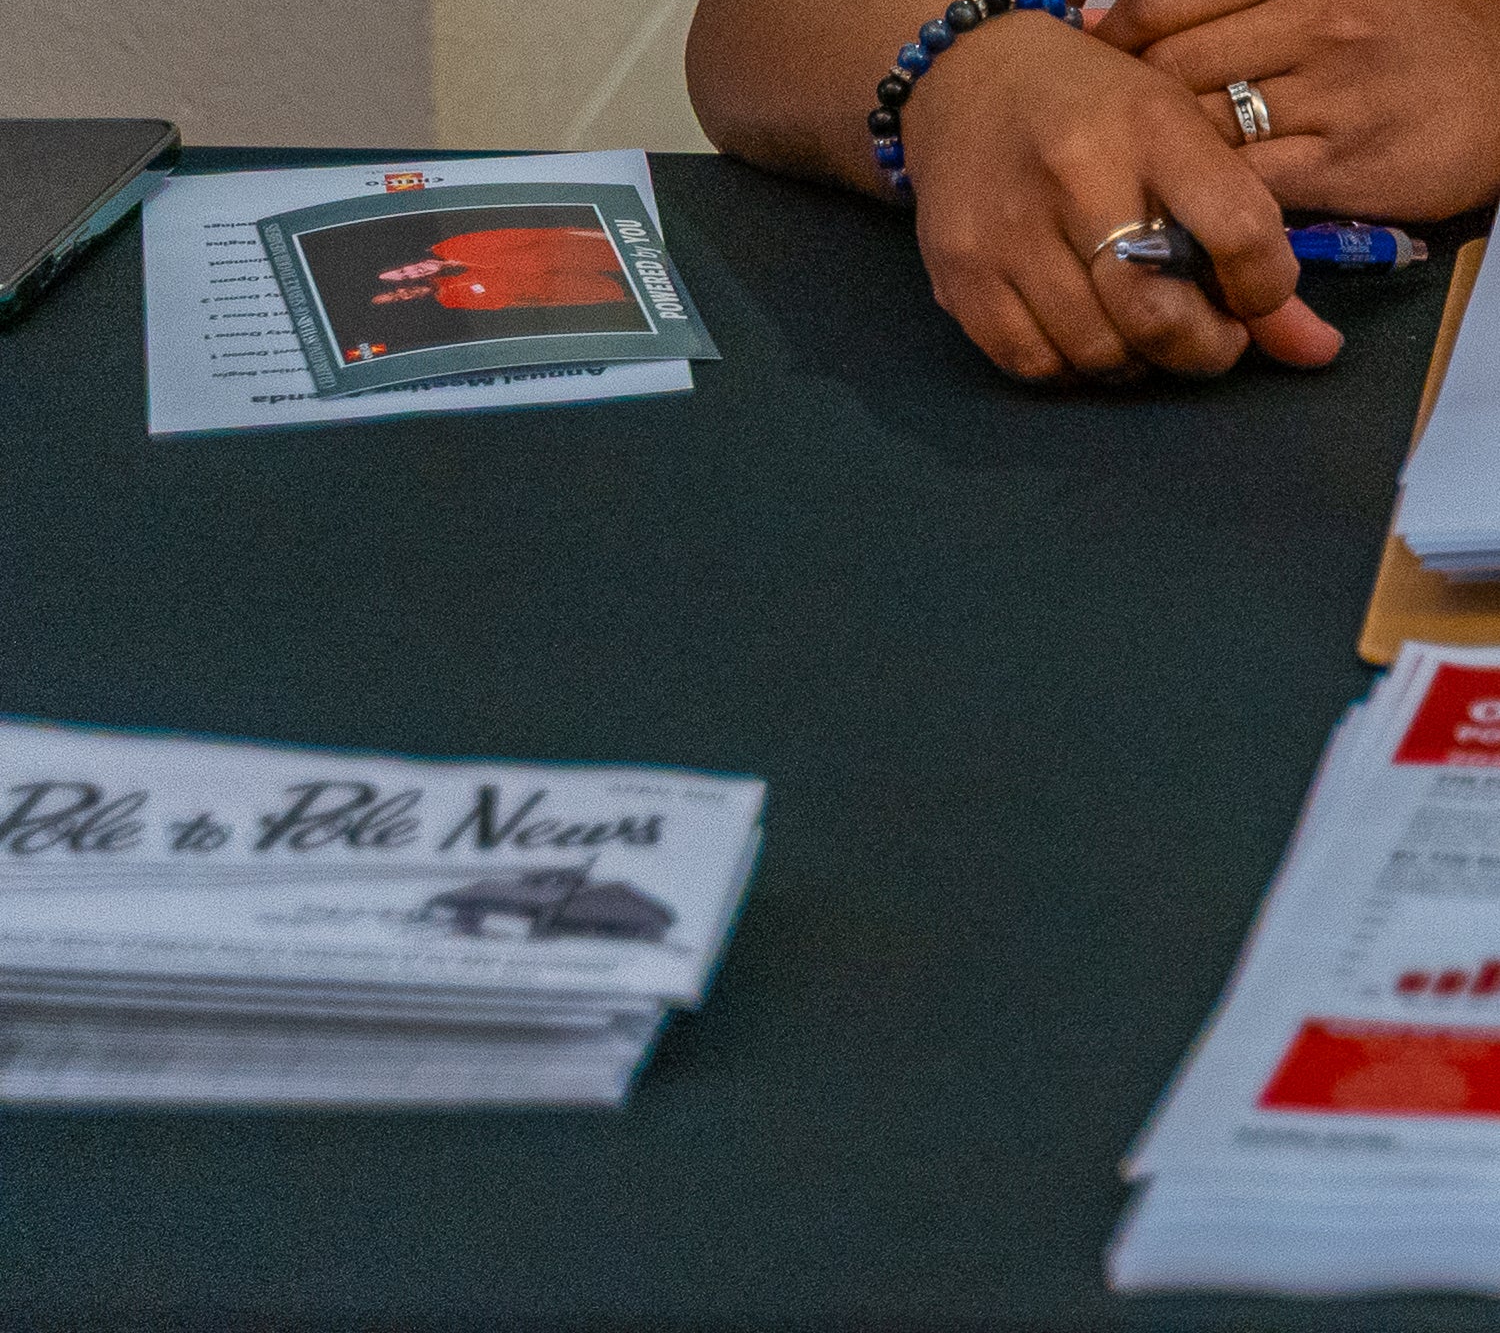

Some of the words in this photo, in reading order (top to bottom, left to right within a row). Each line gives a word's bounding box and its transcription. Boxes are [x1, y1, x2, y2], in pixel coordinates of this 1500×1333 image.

[614, 219, 649, 243] YOU
[630, 246, 662, 258] by
[635, 261, 688, 319] POWERED
[0, 781, 150, 855] Pole
[170, 811, 232, 852] to
[255, 780, 422, 853] Pole
[438, 784, 664, 851] News
